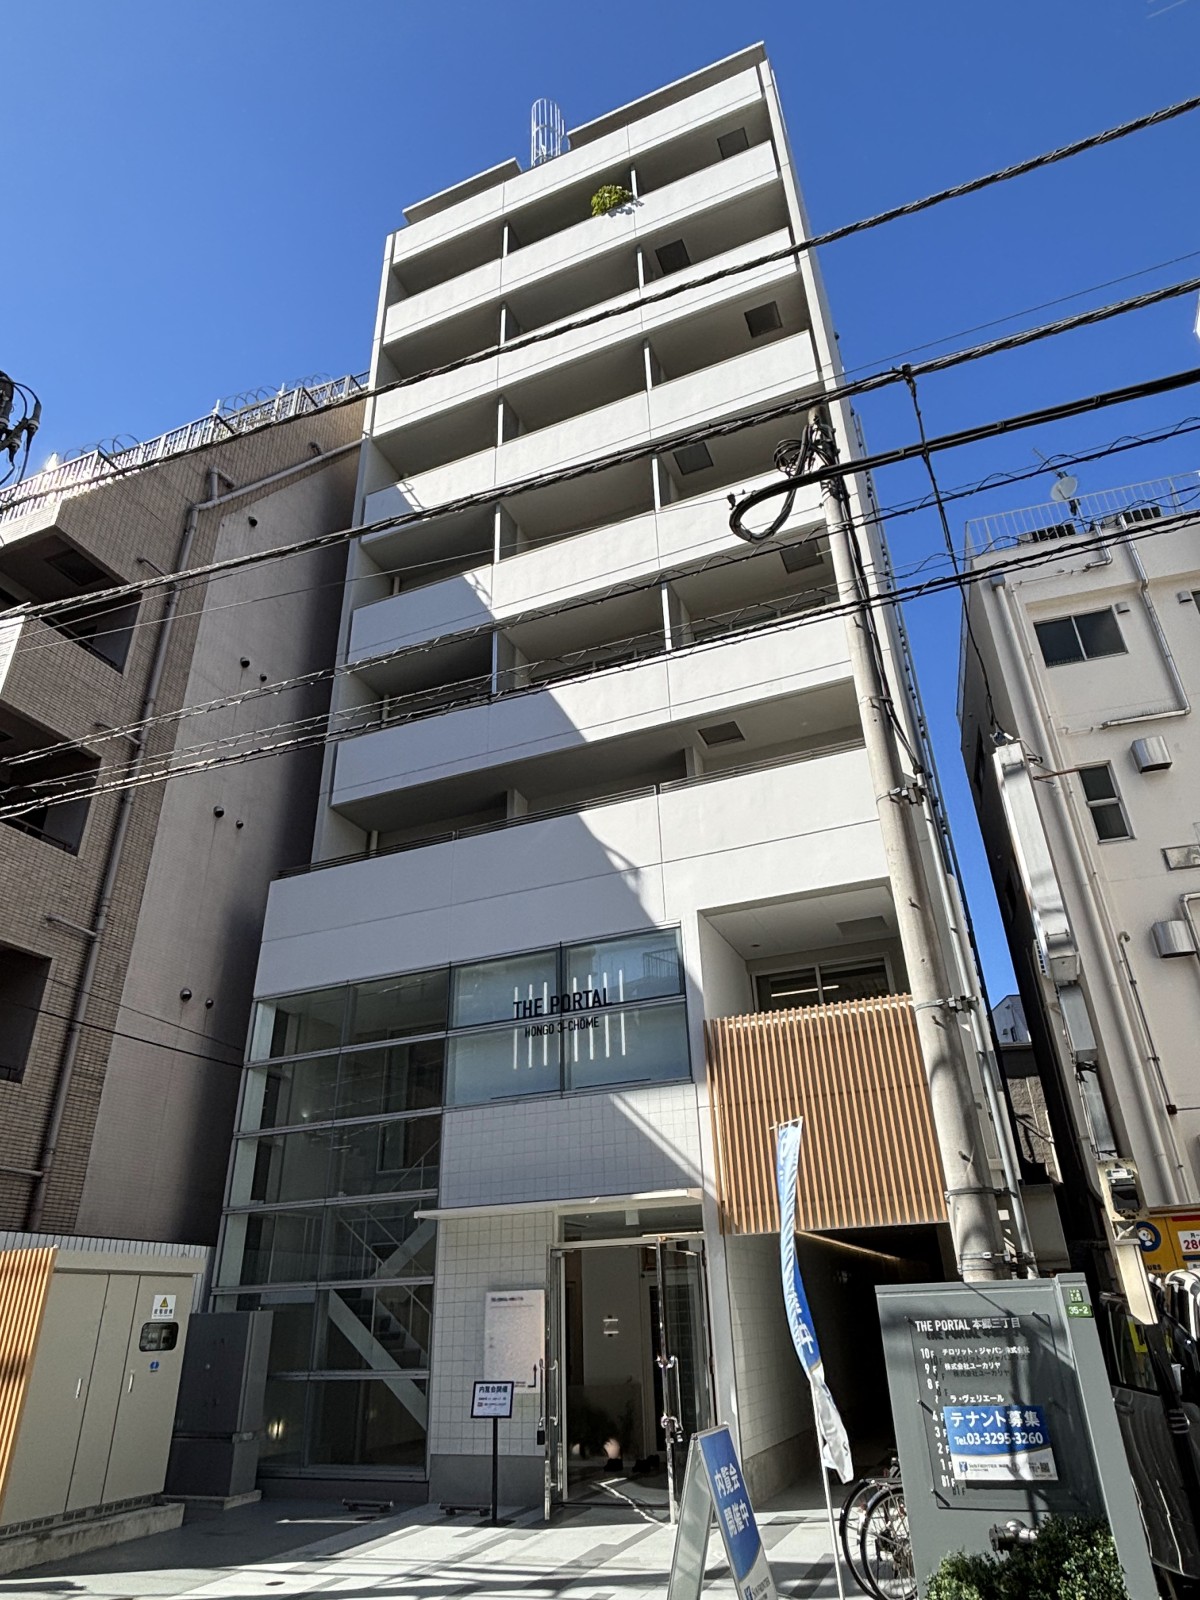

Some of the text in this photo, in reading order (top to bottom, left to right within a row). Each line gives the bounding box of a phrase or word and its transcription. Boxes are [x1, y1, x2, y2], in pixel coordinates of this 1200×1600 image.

[513, 988, 613, 1019] THE PORTAL
[525, 1017, 600, 1038] HONGO 3-CHOME
[1183, 1239, 1200, 1250] 28
[1068, 1306, 1089, 1315] 35-2
[915, 1317, 1021, 1332] THE PORTAL 本郷三丁目
[950, 1410, 1041, 1428] テナント募集
[714, 1462, 741, 1499] 内覧会
[723, 1498, 750, 1538] 開催中
